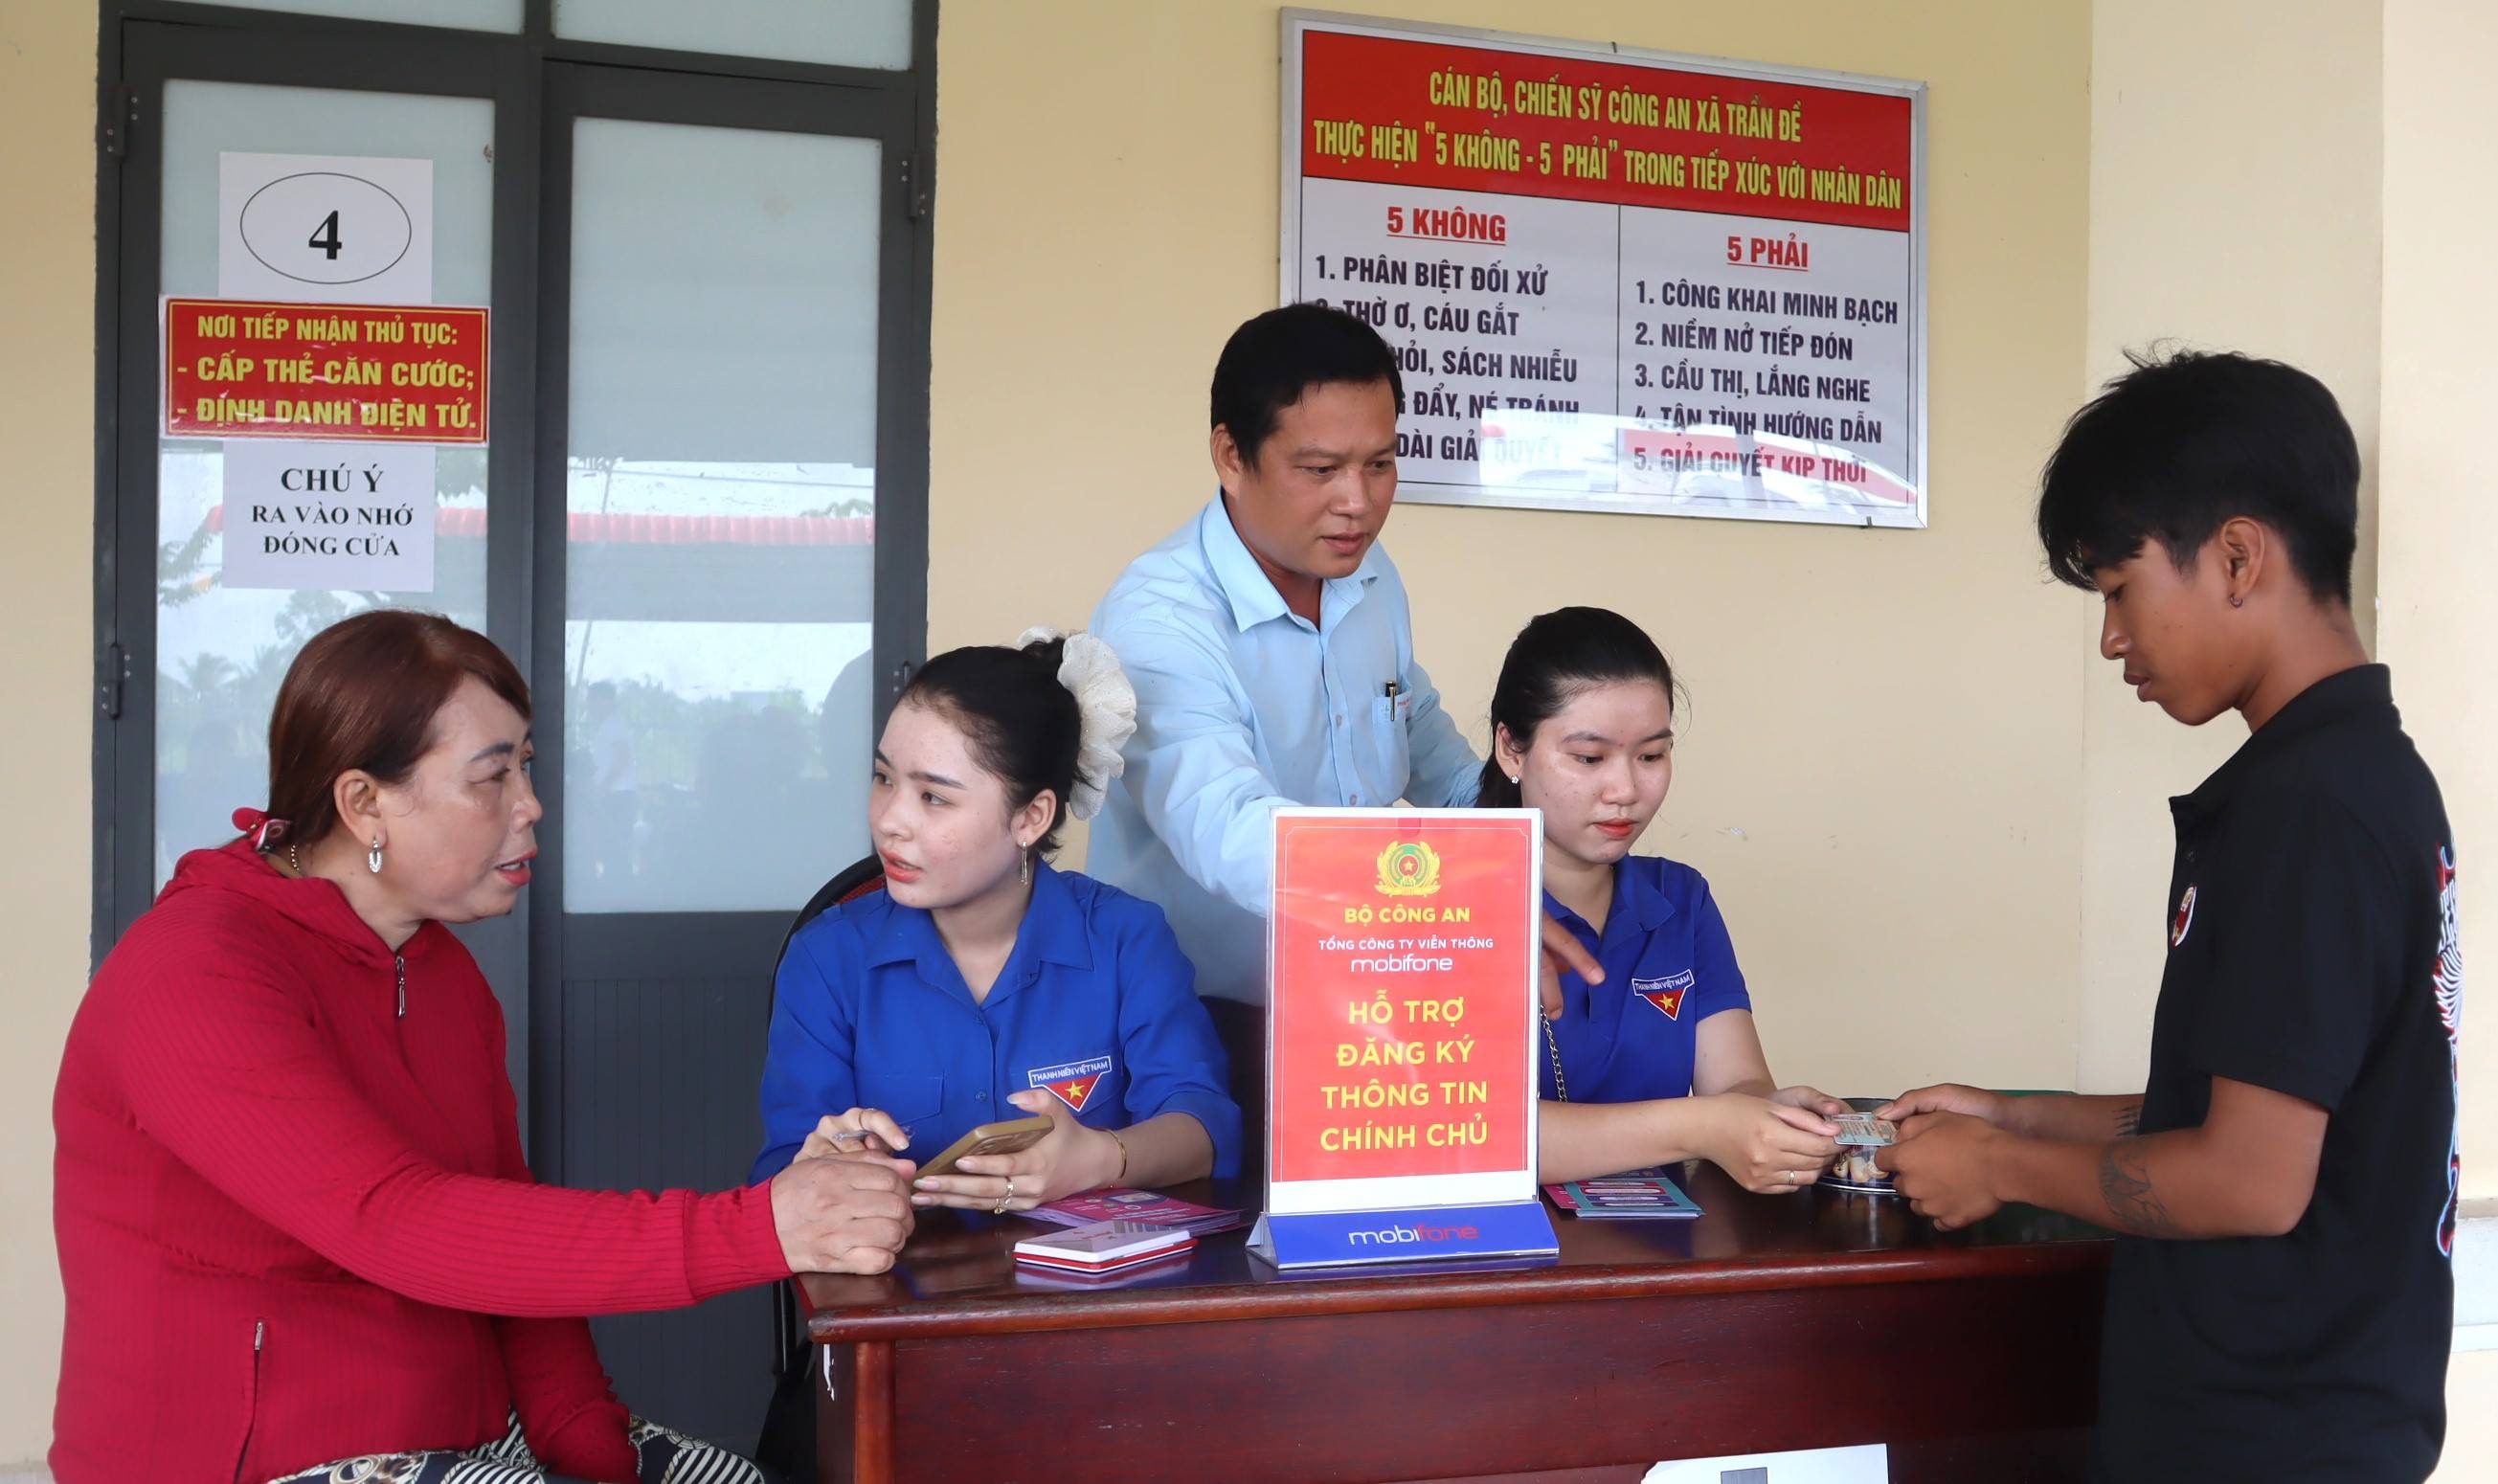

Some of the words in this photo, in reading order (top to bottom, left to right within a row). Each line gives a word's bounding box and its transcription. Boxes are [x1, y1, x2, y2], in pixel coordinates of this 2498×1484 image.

[1429, 66, 1470, 107] CÁN
[1476, 71, 1508, 118] BỘ,
[1515, 74, 1571, 118] CHIẾN
[1578, 82, 1601, 121] SỸ
[1609, 84, 1658, 127] CÔNG
[1665, 97, 1690, 130] AN
[1697, 95, 1721, 133] XÃ
[1726, 94, 1772, 139] TRẦN
[1779, 100, 1801, 143] ĐỀ
[1314, 120, 1364, 164] THỰC
[1371, 121, 1417, 169] HIỆN
[1453, 129, 1519, 171] KHÔNG
[1526, 155, 1534, 164] -
[1540, 143, 1551, 174] 5
[1624, 149, 1685, 188] TRONG
[1691, 148, 1729, 191] TIẾP
[1735, 156, 1771, 195] XÚC
[1777, 160, 1806, 199] VỚI
[1812, 165, 1860, 205] NHÂN
[1866, 170, 1902, 209] DÂN
[308, 211, 342, 259] 4
[1388, 207, 1403, 233] 5
[1412, 206, 1506, 241] KHÔNG
[1727, 236, 1742, 261] 5
[1750, 233, 1808, 267] PHẢI
[1316, 256, 1335, 280] 1.
[1344, 254, 1407, 285] PHÂN
[1415, 259, 1463, 294] BIỆT
[1471, 259, 1508, 293] ĐỐI
[1516, 263, 1548, 296] XỬ
[1394, 302, 1415, 331] Ơ,
[1424, 303, 1469, 332] CÁU
[1477, 304, 1519, 336] GẮT
[1636, 281, 1654, 304] 1.
[1662, 279, 1720, 309] CÔNG
[1727, 287, 1775, 314] KHAI
[1784, 292, 1837, 319] MINH
[1844, 298, 1898, 326] BẠCH
[198, 314, 236, 337] NƠI
[242, 311, 289, 339] TIẾP
[296, 316, 357, 346] NHẬN
[364, 314, 404, 343] THỦ
[411, 322, 458, 348] TỤC:
[1635, 322, 1654, 346] 2.
[1662, 318, 1717, 350] NIỀM
[1724, 322, 1754, 353] NỞ
[1760, 326, 1804, 356] TIẾP
[1811, 331, 1853, 360] ĐÓN
[197, 349, 254, 381] CẤP
[263, 352, 314, 383] THẺ
[324, 356, 381, 385] CĂN
[391, 358, 474, 390] CƯỚC;
[1442, 347, 1502, 377] SÁCH
[1510, 349, 1577, 383] NHIỄU
[1634, 364, 1653, 388] 3.
[1661, 358, 1703, 391] CẦU
[1711, 368, 1748, 398] THỊ,
[1757, 364, 1810, 398] LẮNG
[1817, 376, 1870, 402] NGHE
[195, 397, 264, 427] ĐỊNH
[275, 400, 351, 425] DANH
[360, 398, 426, 431] ĐIỆN
[435, 396, 476, 428] TỬ.
[1413, 382, 1460, 420] ĐẨY,
[1469, 391, 1497, 418] NÉ
[1660, 402, 1701, 436] TẬN
[1709, 405, 1756, 436] TÌNH
[1764, 411, 1834, 440] HƯỚNG
[1840, 407, 1881, 443] DẪN
[1396, 429, 1432, 459] DÀI
[1441, 429, 1481, 461] GIẢ
[1634, 447, 1652, 470] 5.
[1661, 441, 1702, 472] GIẢI
[281, 462, 350, 492] CHÚ
[363, 463, 383, 492] Ý
[252, 505, 285, 523] RA
[294, 502, 349, 525] VÀO
[357, 503, 414, 527] NHỚ
[263, 530, 336, 555] ĐÓNG
[346, 532, 400, 556] CỬA
[1344, 904, 1373, 927] BỘ
[1379, 904, 1435, 923] CÔNG
[1441, 908, 1471, 922] AN
[1318, 934, 1355, 950] TỔNG
[1359, 937, 1394, 950] CÔNG
[1399, 939, 1414, 949] TY
[1418, 933, 1447, 949] VIỄN
[1451, 936, 1494, 948] THÔNG
[1351, 954, 1452, 972] mobifone
[1675, 975, 1691, 986] NAM
[1348, 990, 1393, 1025] HỖ
[1404, 997, 1464, 1027] TRỢ
[1337, 1038, 1426, 1067] ĐĂNG
[1436, 1034, 1474, 1064] KÝ
[1032, 1071, 1058, 1083] THANH
[1074, 1064, 1090, 1075] VIỆT
[1090, 1061, 1108, 1071] NAM
[1321, 1079, 1429, 1109] THÔNG
[1440, 1081, 1487, 1105] TIN
[1320, 1120, 1416, 1151] CHÍNH
[1427, 1113, 1488, 1147] CHỦ
[1349, 1225, 1479, 1245] mobifone
